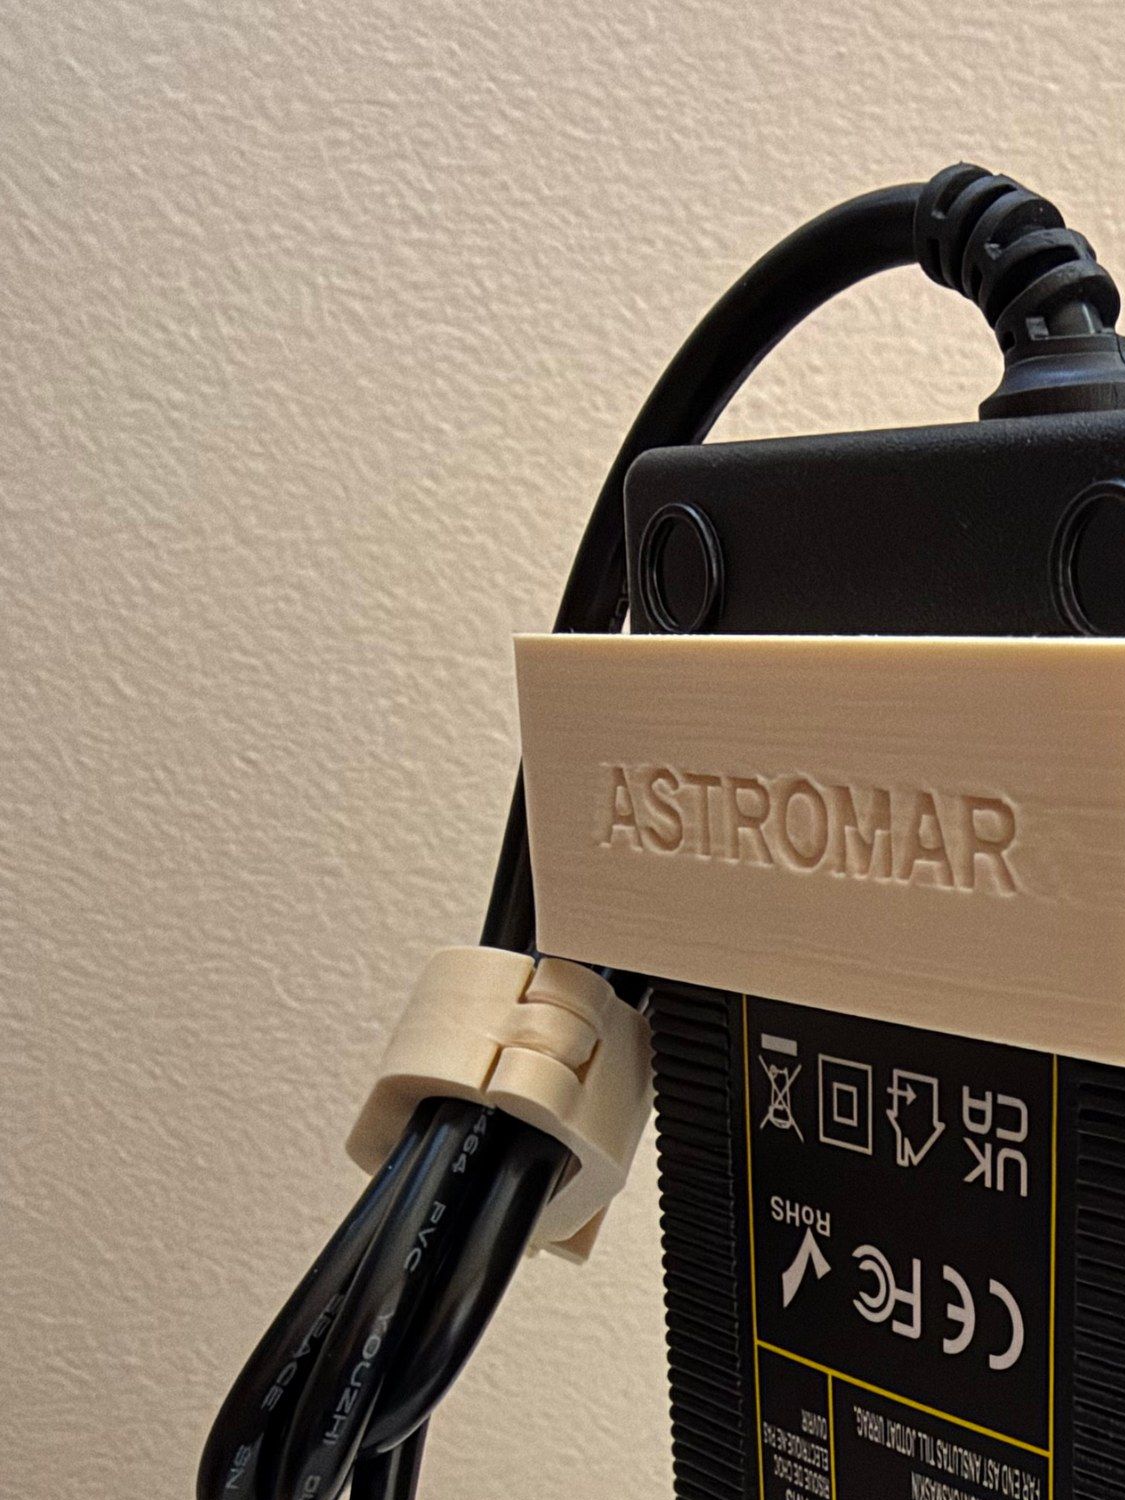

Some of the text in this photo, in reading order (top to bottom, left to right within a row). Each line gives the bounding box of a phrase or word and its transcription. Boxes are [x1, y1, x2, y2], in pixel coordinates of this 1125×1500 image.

[600, 764, 1019, 896] ASTROMAR
[962, 1085, 1028, 1142] CA
[963, 1137, 1027, 1197] UK
[404, 1200, 446, 1272] PVC
[770, 1195, 830, 1237] RoHS
[942, 1264, 1024, 1370] CE
[323, 1306, 396, 1446] YOUZHI
